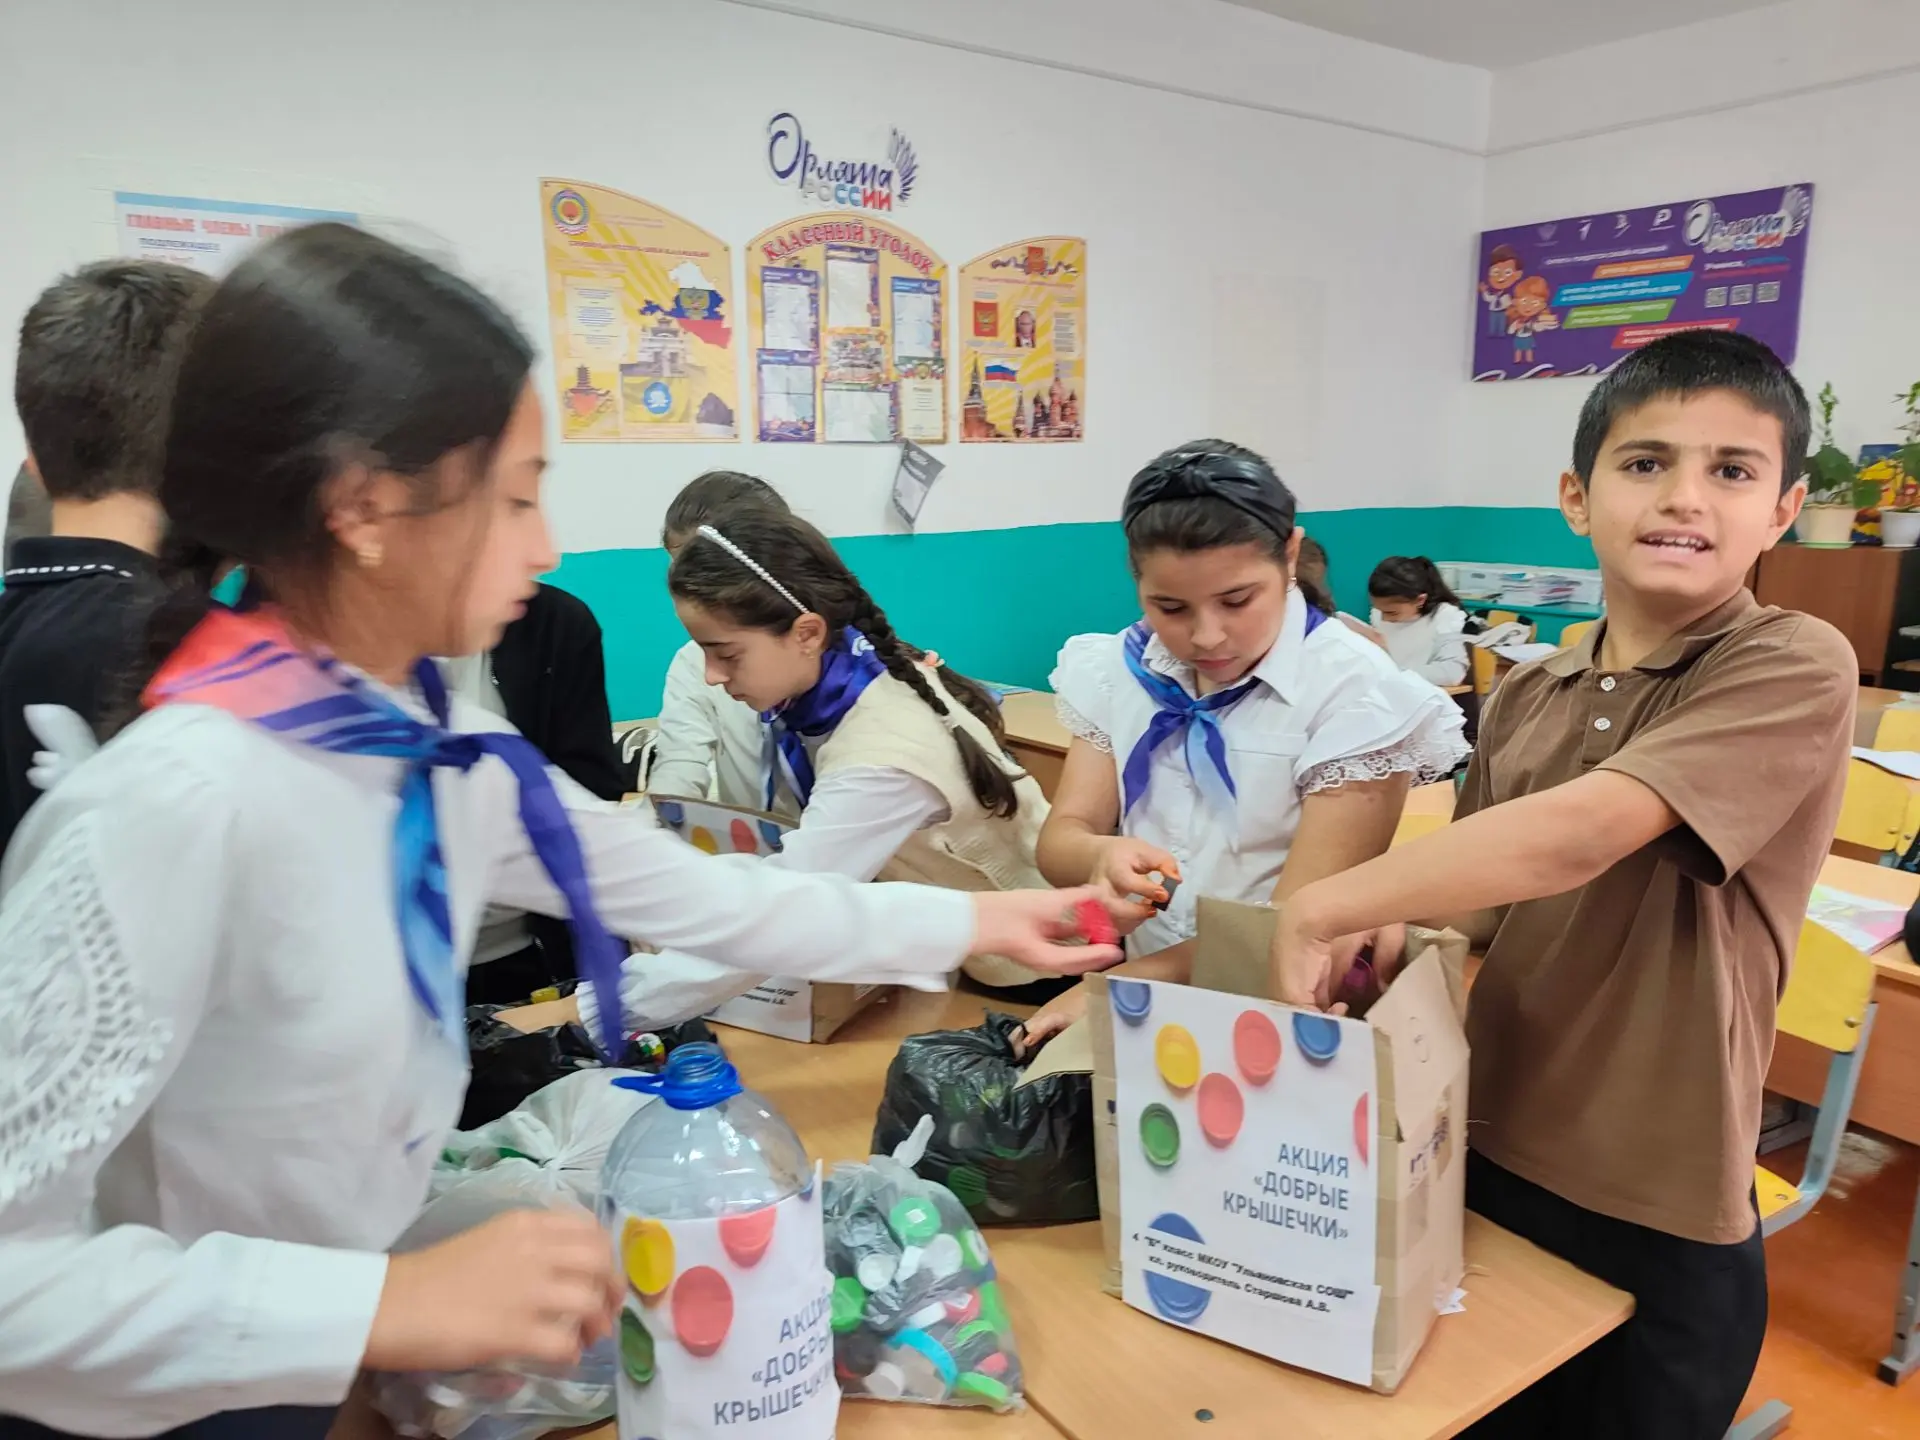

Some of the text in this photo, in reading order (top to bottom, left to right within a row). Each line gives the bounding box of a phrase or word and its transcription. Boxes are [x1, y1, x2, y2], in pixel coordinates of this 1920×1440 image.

[769, 112, 894, 189] Орлята
[802, 180, 892, 211] РОССИИ
[761, 219, 934, 276] КЛАССНЫЙ УГОЛОК
[1278, 1143, 1349, 1179] АКЦИЯ
[1254, 1170, 1349, 1211] «ДОБРЫЕ
[1223, 1190, 1349, 1240] КРЫШЕЧКИ»
[1162, 1243, 1194, 1260] класс
[1165, 1260, 1242, 1291] руководитель
